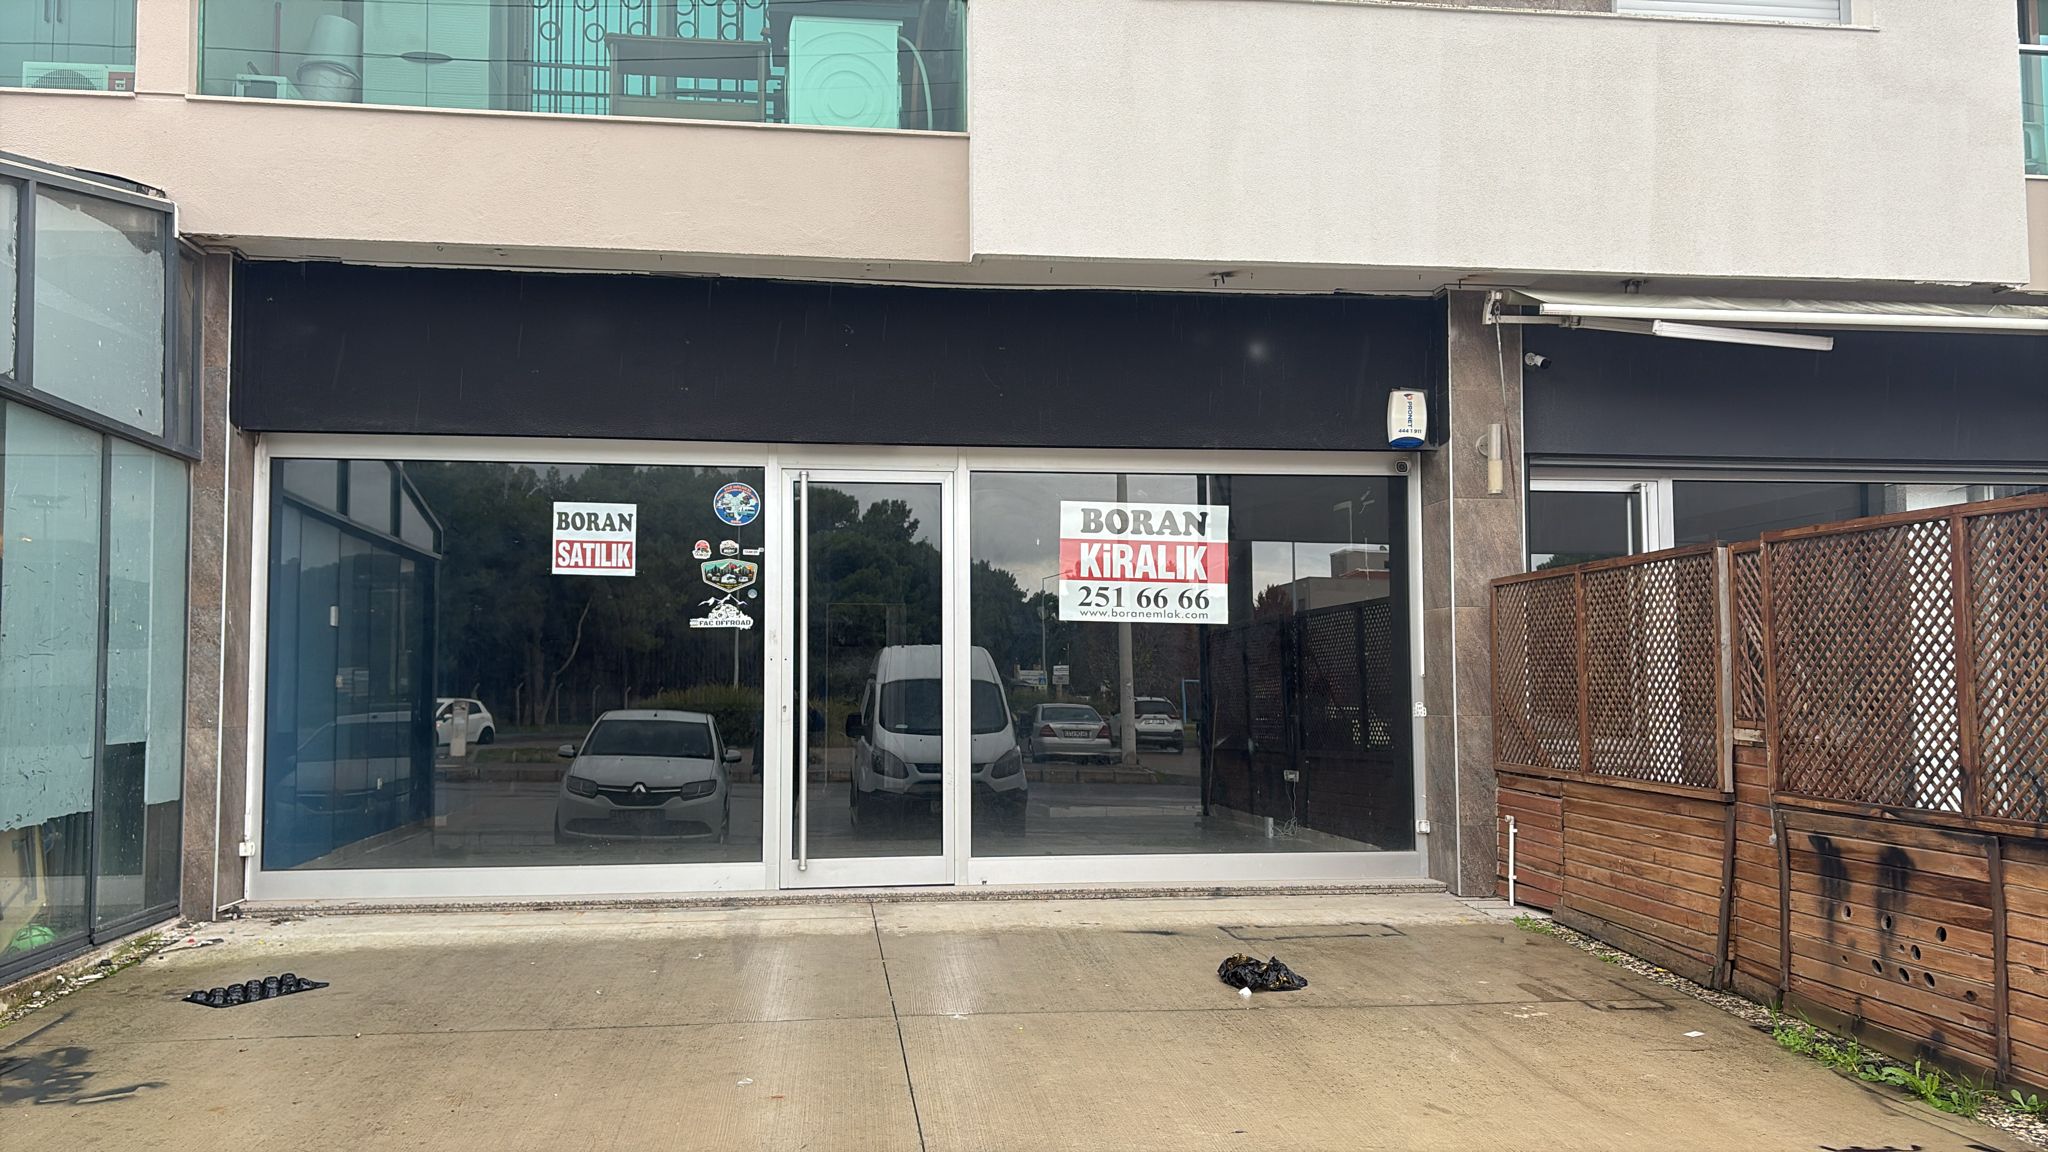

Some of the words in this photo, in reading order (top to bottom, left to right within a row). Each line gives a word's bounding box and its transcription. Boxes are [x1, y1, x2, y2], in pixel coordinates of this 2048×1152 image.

[556, 511, 634, 532] BORAN
[1080, 507, 1209, 537] BORAN
[557, 541, 631, 567] SATILIK
[1078, 585, 1125, 608] 251
[1136, 586, 1169, 609] 66
[1178, 587, 1210, 610] 66
[1079, 608, 1209, 620] www.boranemlak.com
